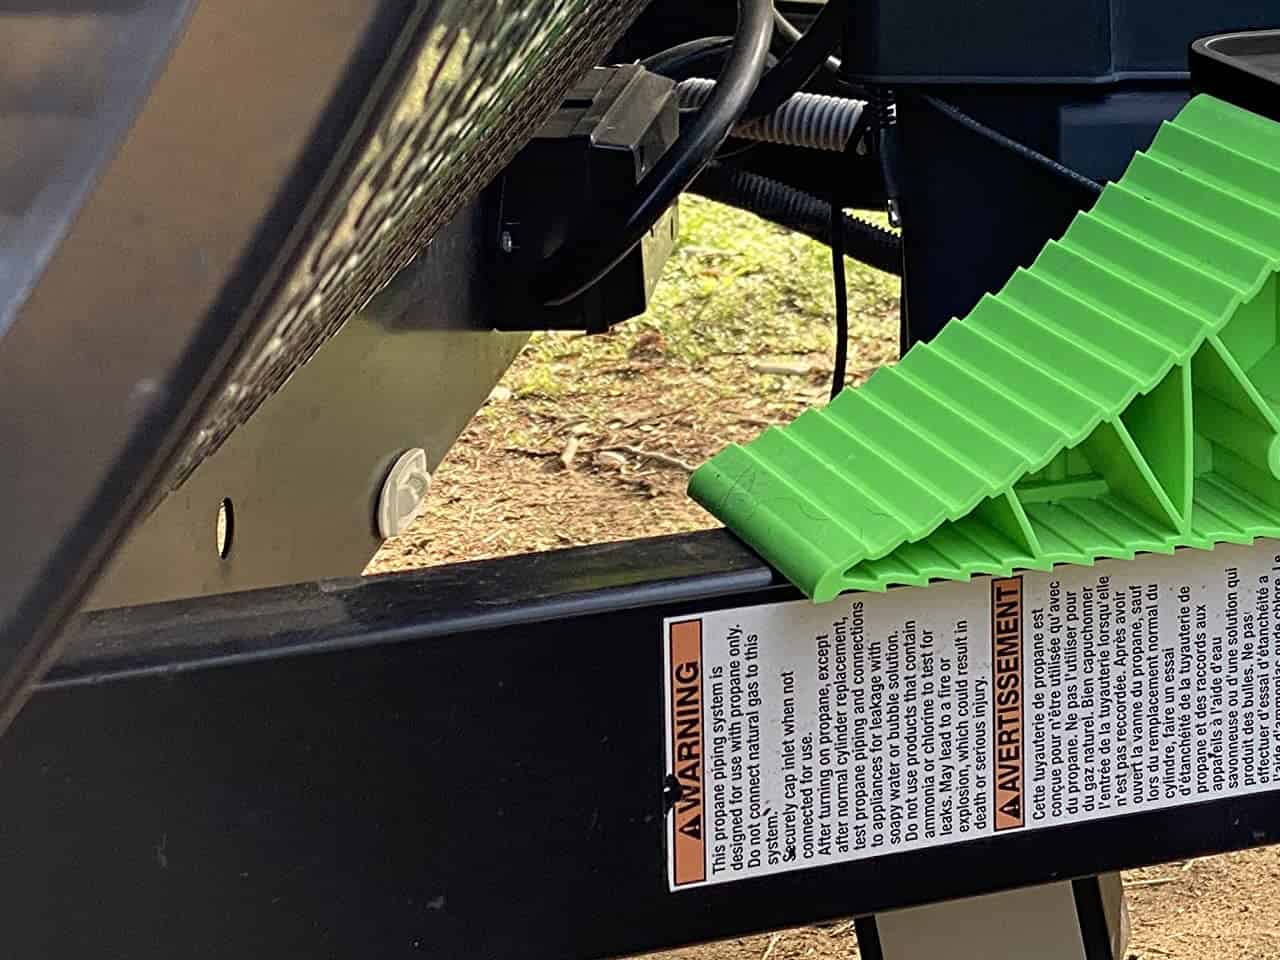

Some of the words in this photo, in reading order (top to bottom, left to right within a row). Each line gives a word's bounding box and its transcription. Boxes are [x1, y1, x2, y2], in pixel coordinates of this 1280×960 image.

[1031, 608, 1044, 629] est
[1047, 582, 1063, 634] qu'avec
[1066, 592, 1079, 622] pour
[726, 625, 742, 657] only.
[744, 635, 757, 661] this
[850, 602, 864, 685] connections
[1080, 587, 1096, 674] capuchonner
[745, 664, 758, 678] to
[816, 635, 831, 681] except
[832, 617, 849, 707] replacement,
[1033, 634, 1046, 689] propane
[1047, 638, 1060, 687] utilisée
[1064, 626, 1077, 681] l'utiliser
[712, 667, 722, 679] is
[729, 661, 744, 718] propane
[780, 672, 793, 694] not
[997, 586, 1021, 792] AVERTISSEMENT
[710, 683, 726, 733] system
[747, 682, 761, 707] gas
[850, 689, 864, 714] and
[1031, 693, 1044, 709] de
[1048, 691, 1061, 730] n'être
[1067, 685, 1080, 709] pas
[1080, 678, 1094, 708] Bien
[781, 698, 794, 736] when
[818, 684, 832, 745] propane,
[1065, 714, 1077, 731] Ne
[676, 661, 700, 811] WARNING
[728, 722, 741, 753] with
[745, 711, 759, 761] natural
[801, 732, 812, 761] use.
[833, 711, 850, 766] cylinder
[851, 718, 868, 761] piping
[1031, 714, 1047, 782] tuyauterie
[1051, 735, 1064, 765] pour
[1081, 712, 1094, 764] naturel.
[710, 737, 727, 780] piping
[731, 756, 742, 781] use
[781, 739, 794, 771] inlet
[819, 749, 830, 766] on
[1067, 735, 1080, 794] propane.
[746, 764, 760, 820] connect
[784, 775, 797, 799] cap
[799, 765, 812, 784] for
[1084, 768, 1097, 791] gaz
[728, 786, 742, 805] for
[816, 769, 833, 820] turning
[834, 770, 848, 817] normal
[854, 765, 868, 821] propane
[1032, 786, 1045, 820] Cette
[1051, 769, 1064, 817] conçue
[1065, 798, 1078, 814] du
[1082, 795, 1094, 812] du
[714, 785, 728, 841] propane
[799, 788, 814, 859] connected
[729, 809, 746, 871] designed
[747, 823, 760, 846] not
[766, 811, 780, 865] system.
[782, 804, 798, 862] Securely
[817, 824, 831, 856] After
[835, 822, 848, 853] after
[853, 824, 866, 850] test
[712, 845, 725, 875] This
[747, 850, 760, 868] Do
